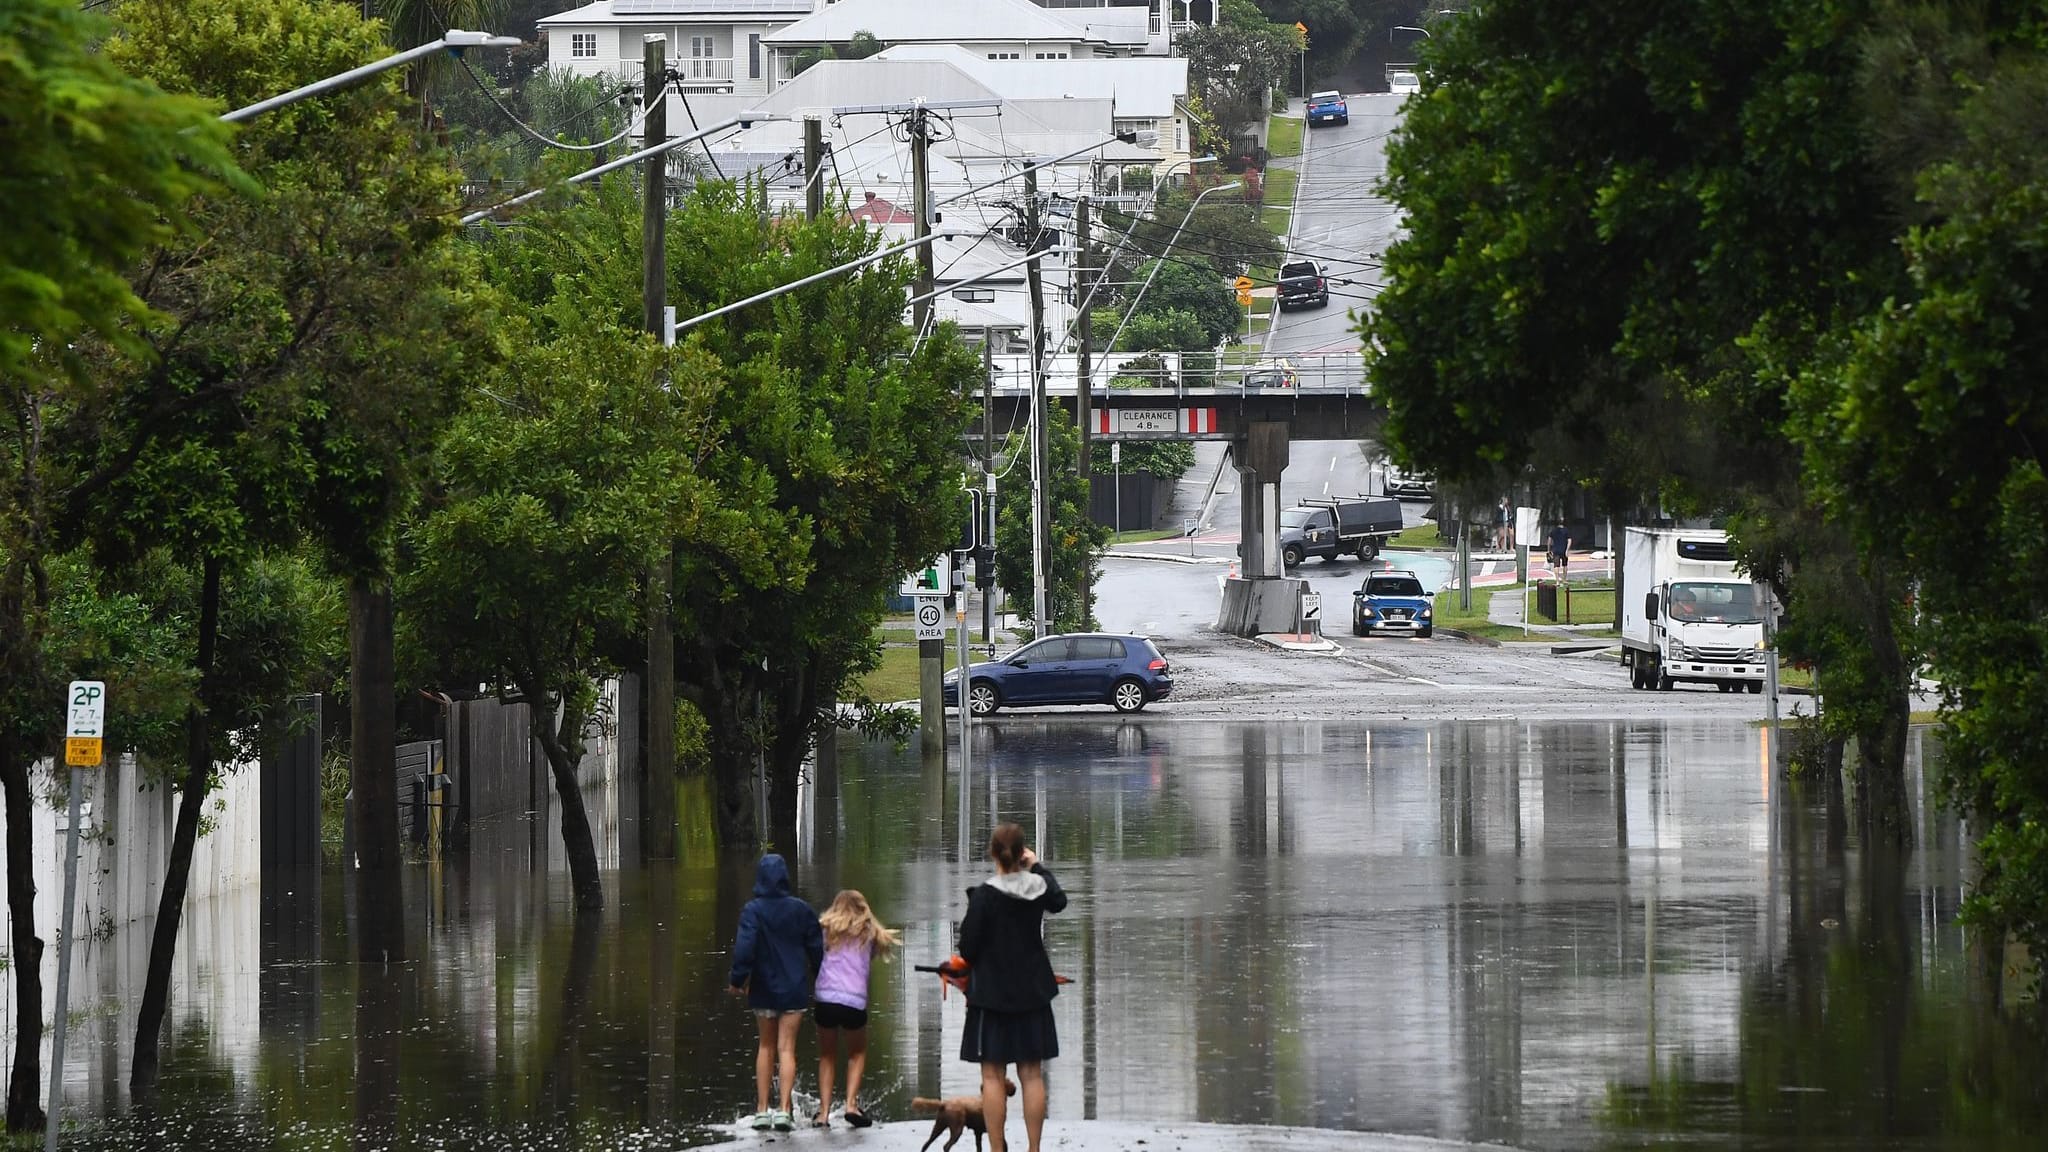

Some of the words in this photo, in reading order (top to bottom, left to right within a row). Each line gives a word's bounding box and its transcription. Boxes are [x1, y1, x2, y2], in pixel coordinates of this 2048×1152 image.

[1123, 412, 1173, 420] CLEARANCE
[922, 610, 938, 621] 40
[919, 629, 942, 637] AREA
[73, 686, 101, 706] 2P
